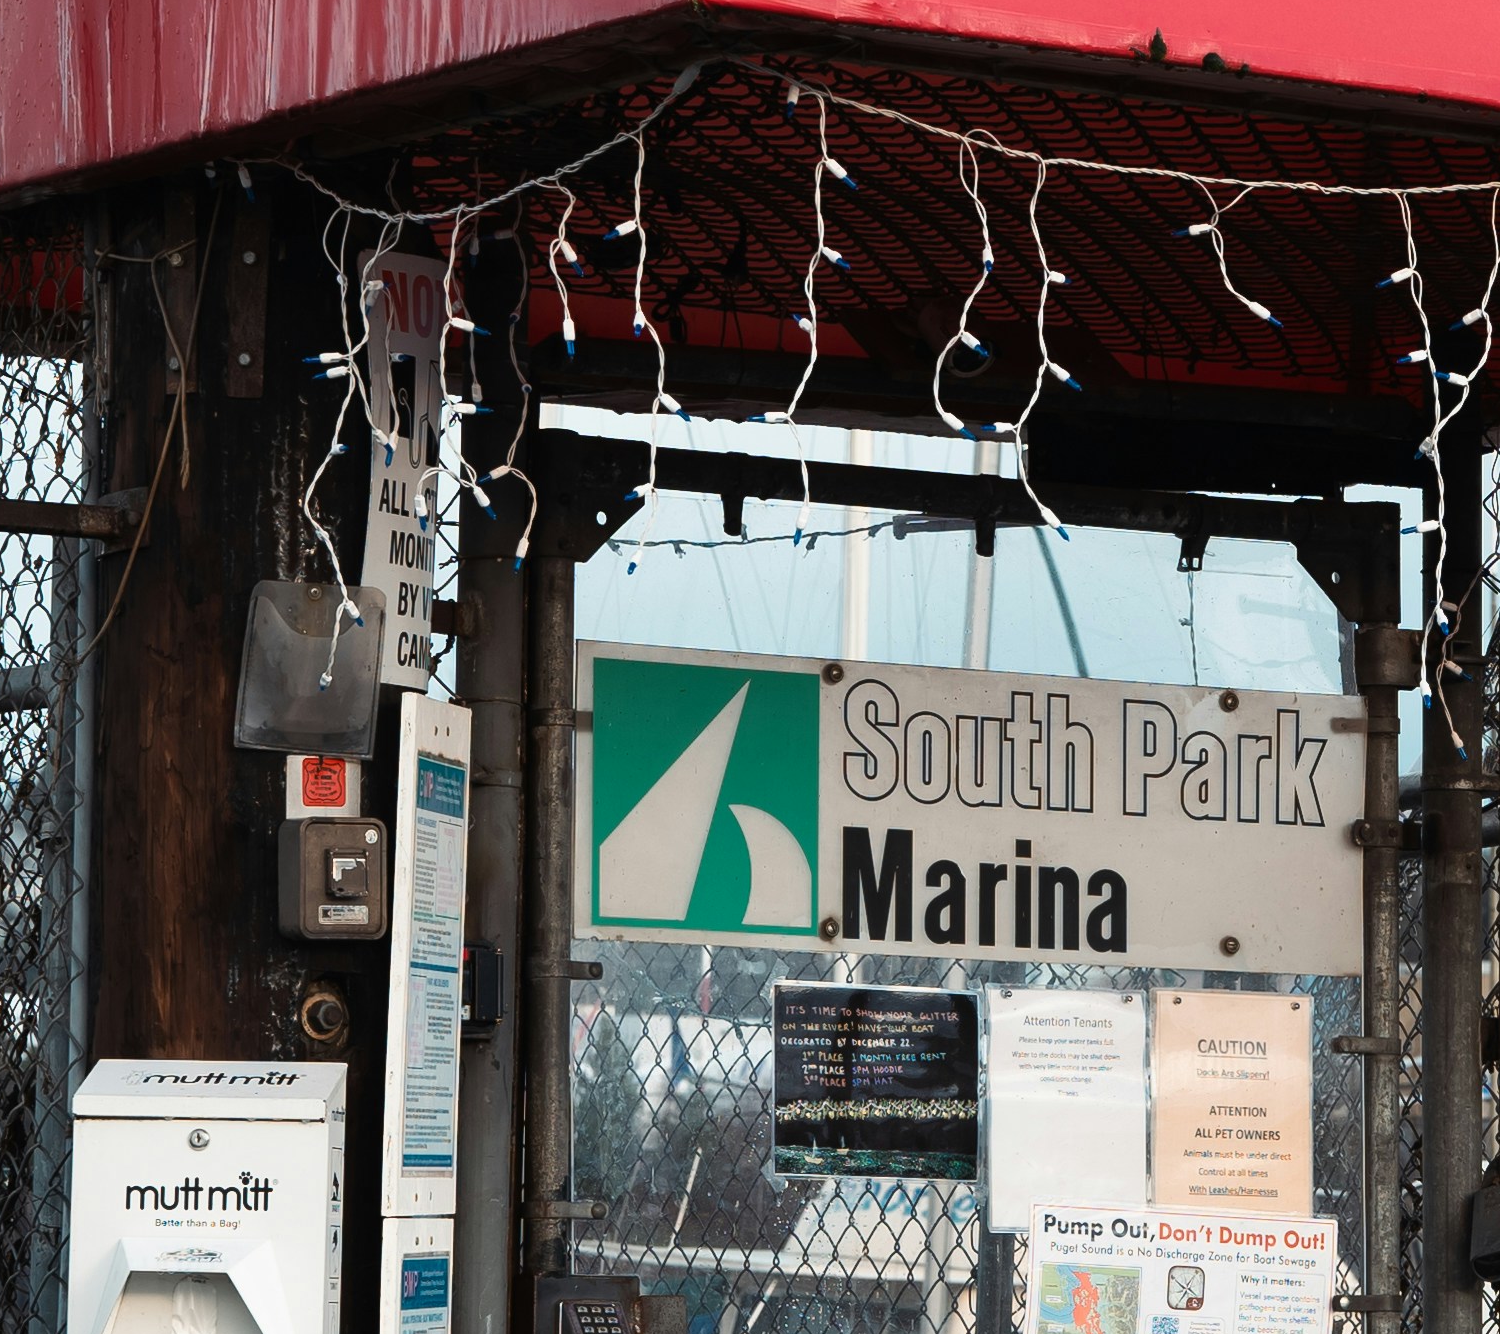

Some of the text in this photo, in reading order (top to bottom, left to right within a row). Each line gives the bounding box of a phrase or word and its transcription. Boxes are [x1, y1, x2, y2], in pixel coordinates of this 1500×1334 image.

[379, 479, 409, 517] ALL
[397, 582, 419, 618] BY
[842, 678, 1328, 828] South Park
[842, 826, 1128, 953] Marina
[1023, 1016, 1112, 1028] Attention Tenants
[1197, 1039, 1267, 1056] CAUTION
[860, 1054, 891, 1062] MONTH
[896, 1054, 916, 1062] FREE
[920, 1053, 946, 1061] RENT
[142, 1071, 300, 1085] mutt mitt
[852, 1066, 869, 1074] SPM
[1209, 1105, 1267, 1117] ATTENTION
[1195, 1128, 1280, 1140] ALL PET OWNERS
[126, 1171, 273, 1211] mutt mitt
[155, 1219, 183, 1227] Better
[187, 1219, 207, 1227] than
[220, 1220, 240, 1230] Bag!
[1044, 1214, 1324, 1252] Pump Out, Don't Dump Out!
[1050, 1242, 1316, 1269] Puget Sound is a No Discharge Zone for Boat Sewage
